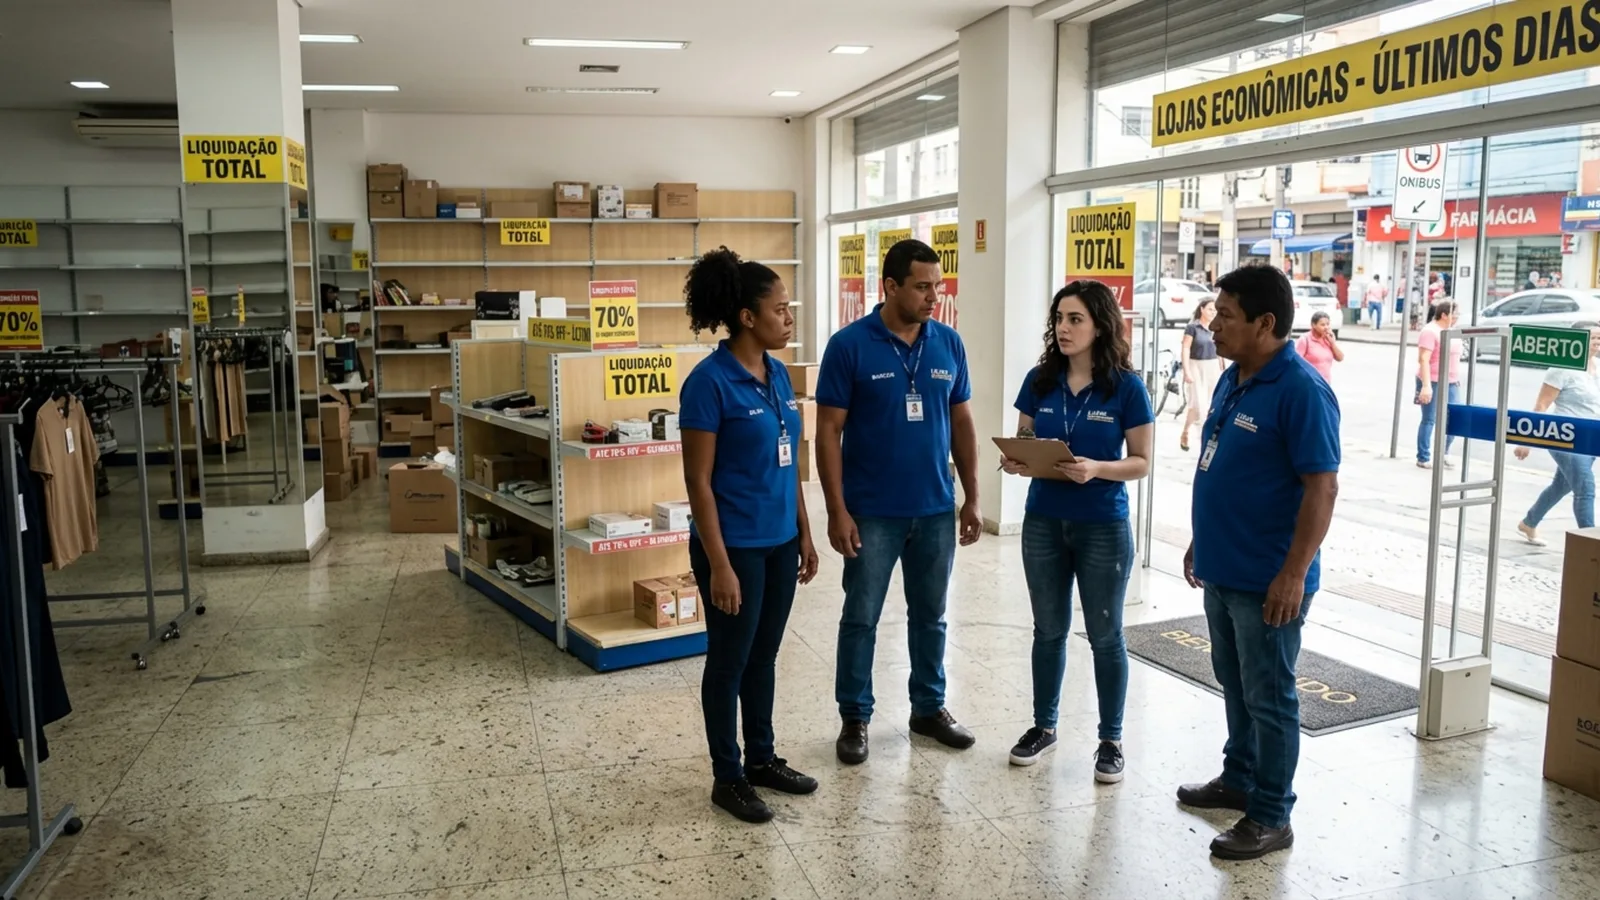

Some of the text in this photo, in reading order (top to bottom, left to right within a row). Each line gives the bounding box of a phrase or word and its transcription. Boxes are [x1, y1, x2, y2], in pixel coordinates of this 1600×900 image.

[1157, 95, 1207, 137] LOJAS
[1211, 61, 1349, 127] ECONÔMICAS
[1373, 22, 1503, 95] ÚLTIMOS
[1513, 0, 1600, 67] DIAS
[187, 138, 278, 158] LIQUIDAÇÃO
[202, 159, 267, 179] TOTAL
[1399, 176, 1441, 190] ONIBUS
[1070, 207, 1131, 236] LIQUIDAÇÃO
[1074, 238, 1125, 270] TOTAL
[595, 305, 635, 328] 70%
[1512, 335, 1584, 359] ABERTO
[609, 354, 672, 371] LIQUIDAÇÃO
[611, 372, 671, 395] TOTAL
[1506, 416, 1575, 442] LOJAS
